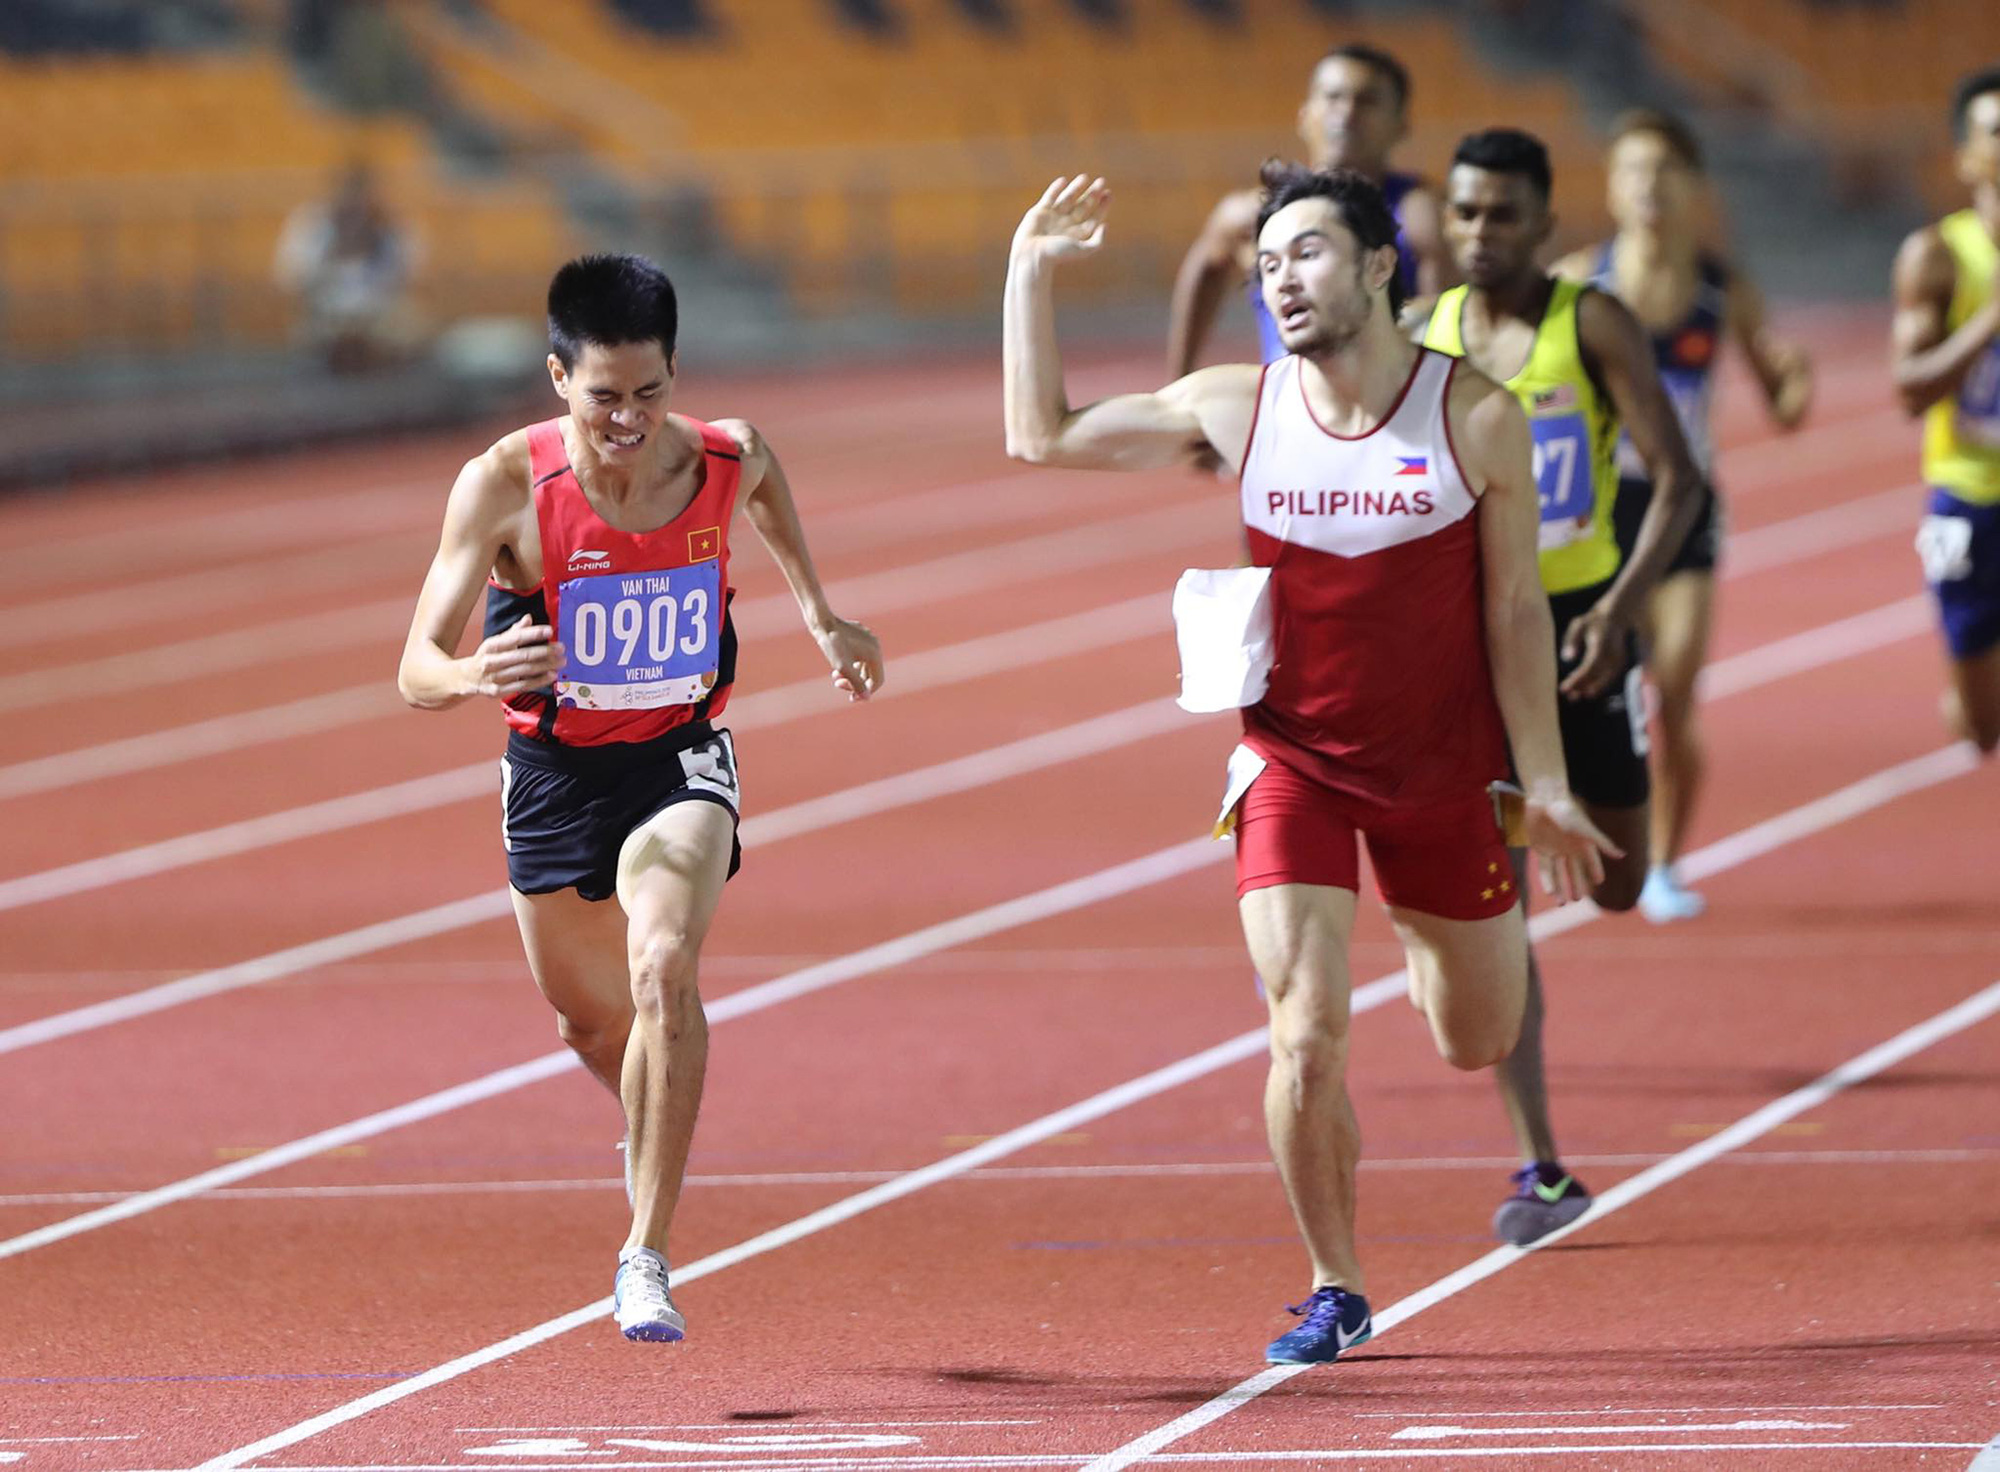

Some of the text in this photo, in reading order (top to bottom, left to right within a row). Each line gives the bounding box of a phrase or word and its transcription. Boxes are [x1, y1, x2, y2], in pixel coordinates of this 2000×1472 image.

[1268, 490, 1435, 516] PILIPINAS
[568, 560, 610, 572] LI-NING
[622, 577, 670, 597] VAN THAI
[575, 588, 707, 666] 0903
[625, 665, 664, 681] VIETNAM
